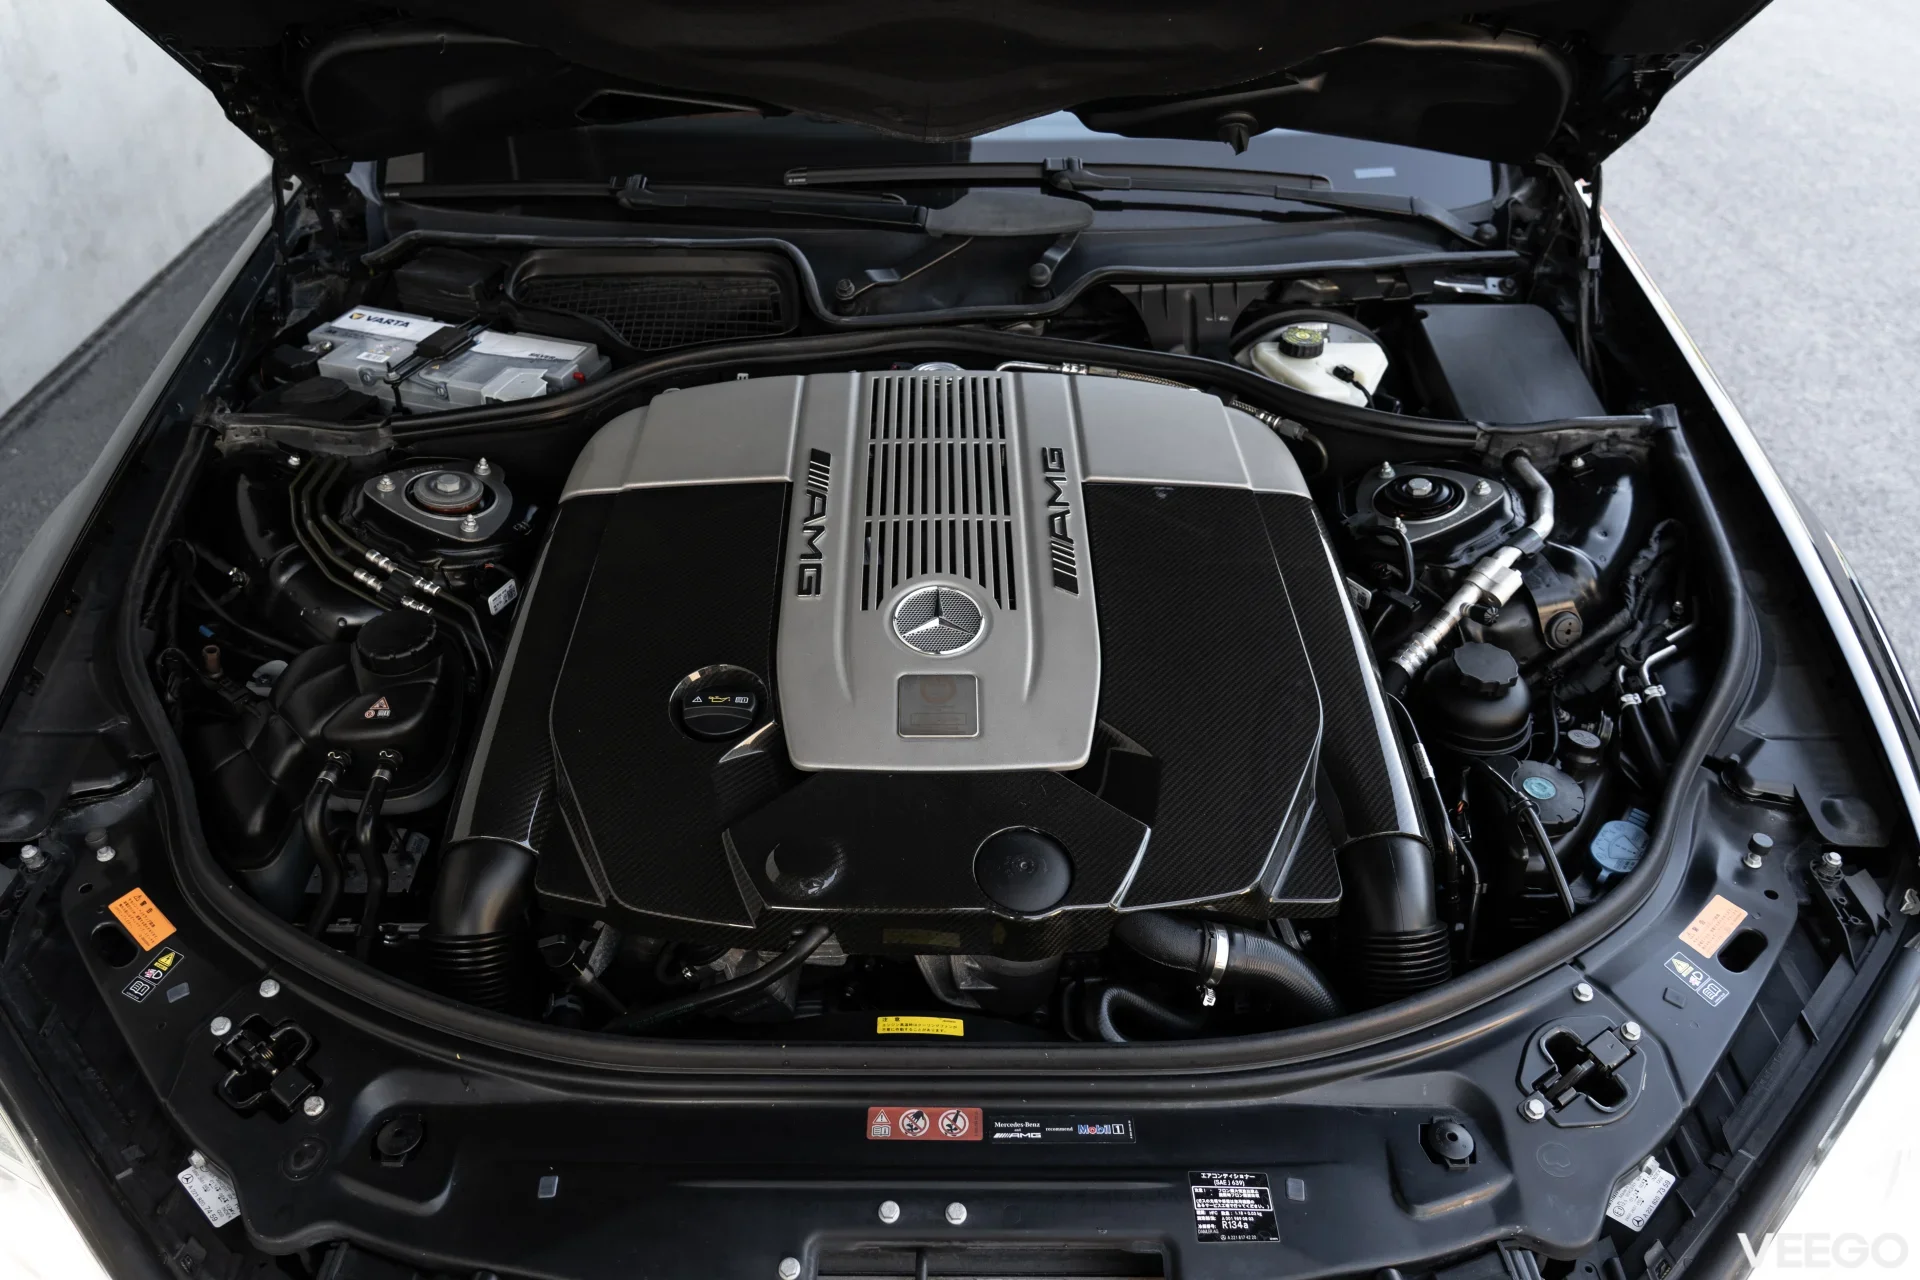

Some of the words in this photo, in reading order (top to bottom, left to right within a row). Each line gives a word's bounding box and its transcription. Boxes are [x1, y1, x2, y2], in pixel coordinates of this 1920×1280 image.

[366, 315, 410, 328] VARTA
[1042, 446, 1075, 544] AMG
[797, 488, 829, 597] AMG
[1077, 1123, 1111, 1135] Mobil
[204, 1205, 213, 1215] 74
[209, 1213, 219, 1223] 59
[1221, 1220, 1249, 1230] R134a
